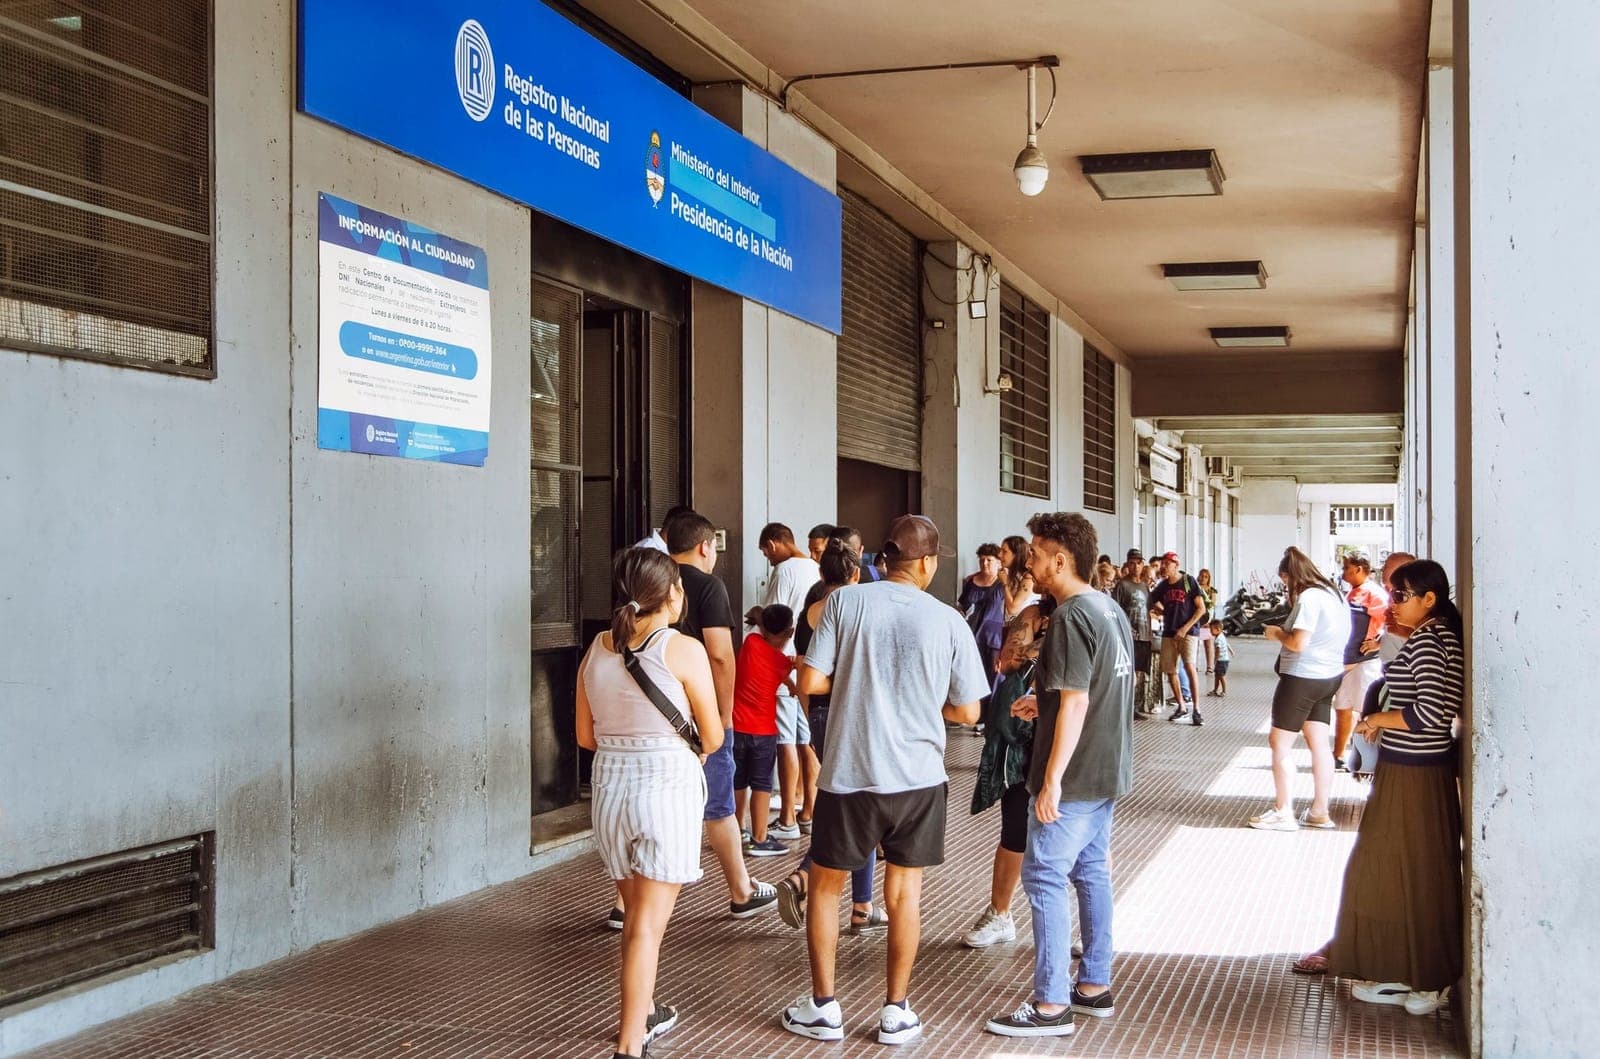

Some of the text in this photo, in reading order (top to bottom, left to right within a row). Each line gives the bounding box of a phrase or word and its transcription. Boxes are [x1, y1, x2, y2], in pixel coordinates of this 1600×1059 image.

[504, 63, 610, 143] Registro Nacional
[504, 101, 600, 169] de las Personas
[671, 141, 760, 206] Ministerio del Interior
[338, 214, 476, 270] INFORMACIÓN AL CIUDADANO
[671, 192, 793, 271] Presidencia de la Nación
[338, 272, 350, 282] DNI
[355, 277, 385, 292] Nacionales
[439, 299, 467, 314] Extranjeros
[362, 268, 382, 280] Centro
[371, 306, 387, 318] Lunes
[392, 312, 412, 324] viernes
[412, 318, 420, 326] de
[420, 319, 424, 327] 8
[429, 321, 437, 329] 20
